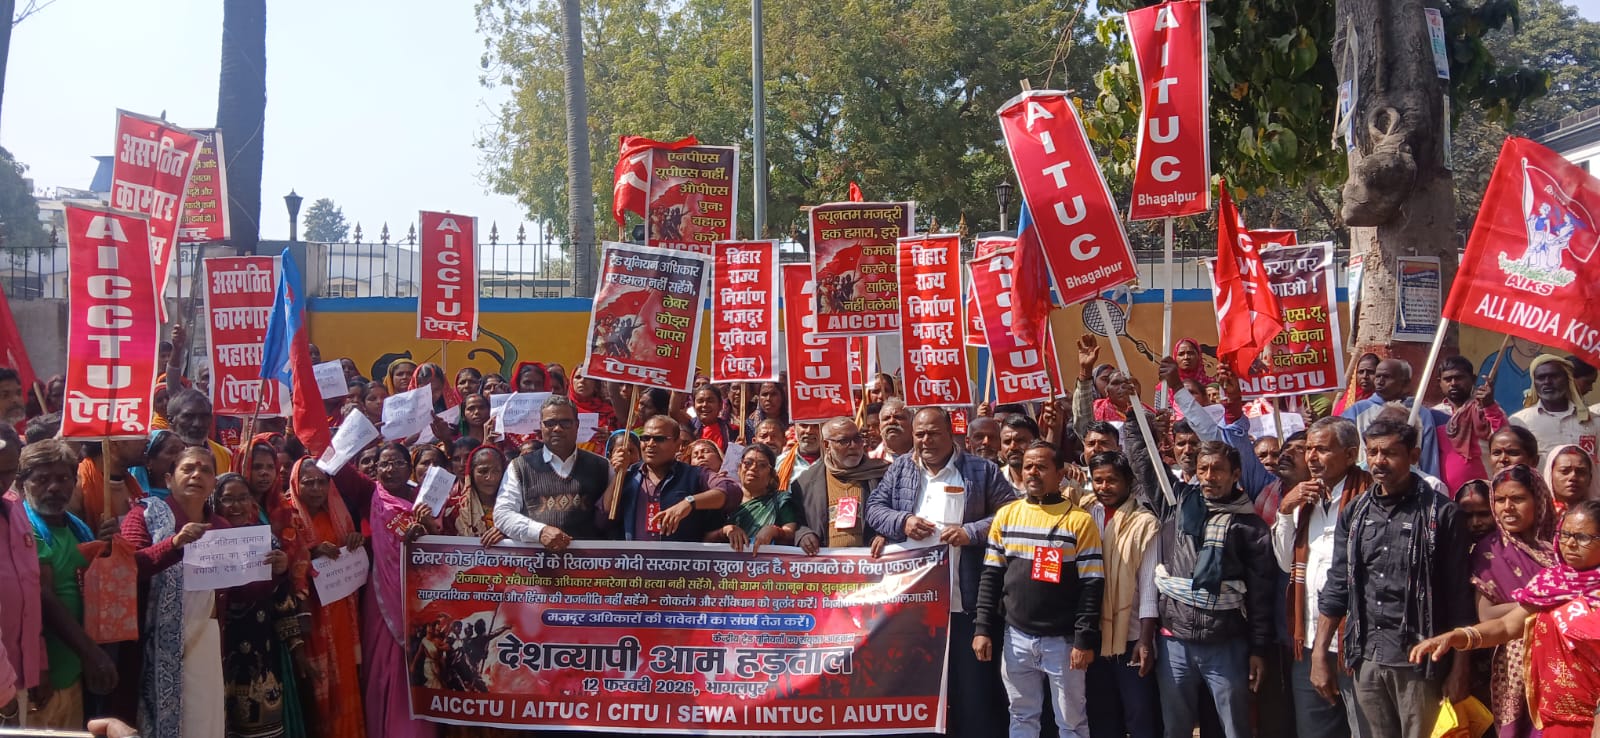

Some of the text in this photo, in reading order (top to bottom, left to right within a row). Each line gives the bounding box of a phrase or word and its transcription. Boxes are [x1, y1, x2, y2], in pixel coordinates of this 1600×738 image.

[1149, 5, 1182, 182] AITUC
[667, 152, 720, 164] एनपीएस
[655, 166, 698, 181] यूपीएस
[1026, 101, 1101, 261] AITUC
[680, 183, 729, 196] ओपीएस
[1138, 190, 1197, 207] Bhagalpur
[691, 216, 727, 228] बहाल
[818, 206, 903, 226] न्यूनतम मजदूरी
[821, 229, 841, 240] हक
[880, 225, 900, 240] इसे
[726, 247, 762, 265] बिहार
[862, 243, 897, 257] कमजो
[910, 245, 948, 266] बिहार
[436, 217, 462, 316] AICCTU
[623, 255, 658, 273] यूनियन
[659, 260, 701, 277] अधिकार
[728, 268, 760, 284] राज्य
[861, 263, 890, 275] करने
[1065, 261, 1123, 289] Bhagalpur
[212, 264, 272, 294] असंगठित
[606, 273, 618, 284] पर
[619, 273, 648, 288] हमला
[648, 275, 667, 291] नहीं
[914, 272, 946, 291] राज्य
[1505, 273, 1555, 296] AIKS
[85, 216, 133, 389] AICCTU
[662, 295, 690, 310] लेबर
[720, 287, 767, 306] निर्माण
[844, 299, 864, 312] नहीं
[907, 295, 955, 318] निर्माण
[722, 309, 764, 329] मजदूर
[827, 314, 900, 330] AICCTU
[1475, 293, 1511, 323] ALL
[1508, 301, 1561, 336] INDIA
[655, 328, 687, 343] वापस
[718, 329, 767, 351] यूनियन
[911, 322, 954, 345] मजदूर
[1290, 327, 1325, 344] बेचना
[907, 345, 959, 373] यूनियन
[1239, 370, 1326, 393] AICCTU
[412, 548, 443, 564] लेबर
[502, 548, 544, 573] मजदूरों
[546, 554, 560, 569] के
[563, 553, 613, 571] खिलाफ
[614, 554, 644, 571] मोदी
[646, 558, 691, 572] सरकार
[692, 559, 710, 572] का
[712, 559, 745, 576] खुला
[746, 559, 769, 577] युद्ध
[789, 558, 841, 578] मुकाबले
[841, 559, 856, 575] के
[858, 558, 883, 575] लिए
[456, 573, 490, 585] रोजगार
[492, 573, 503, 585] के
[505, 573, 552, 586] संवैधानिक
[553, 575, 592, 587] अधिकार
[594, 576, 627, 588] मनरेगा
[629, 577, 642, 588] की
[644, 578, 666, 589] हत्या
[740, 581, 760, 591] ग्राम
[762, 579, 773, 591] जी
[776, 581, 803, 594] कानून
[806, 582, 819, 592] का
[504, 590, 524, 602] और
[525, 589, 547, 603] हिंसा
[549, 590, 562, 603] की
[564, 592, 602, 605] राजनीति
[659, 593, 696, 607] लोकतंत्र
[699, 594, 717, 607] और
[718, 595, 755, 608] संविधान
[757, 595, 770, 608] को
[772, 595, 794, 610] बुलंद
[547, 611, 585, 625] मजदूर
[589, 611, 641, 625] अधिकारों
[645, 612, 661, 625] की
[664, 612, 708, 626] दावेदारी
[711, 614, 726, 626] का
[730, 612, 758, 627] संघर्ष
[760, 613, 781, 627] तेज
[497, 634, 855, 682] देशव्यापी आम हड़ताल
[582, 677, 768, 700] 12 फरवरी 2026, भागलपुर
[430, 695, 929, 723] AICCTU AITUC CITU SEWA INTUC AIUTUC
